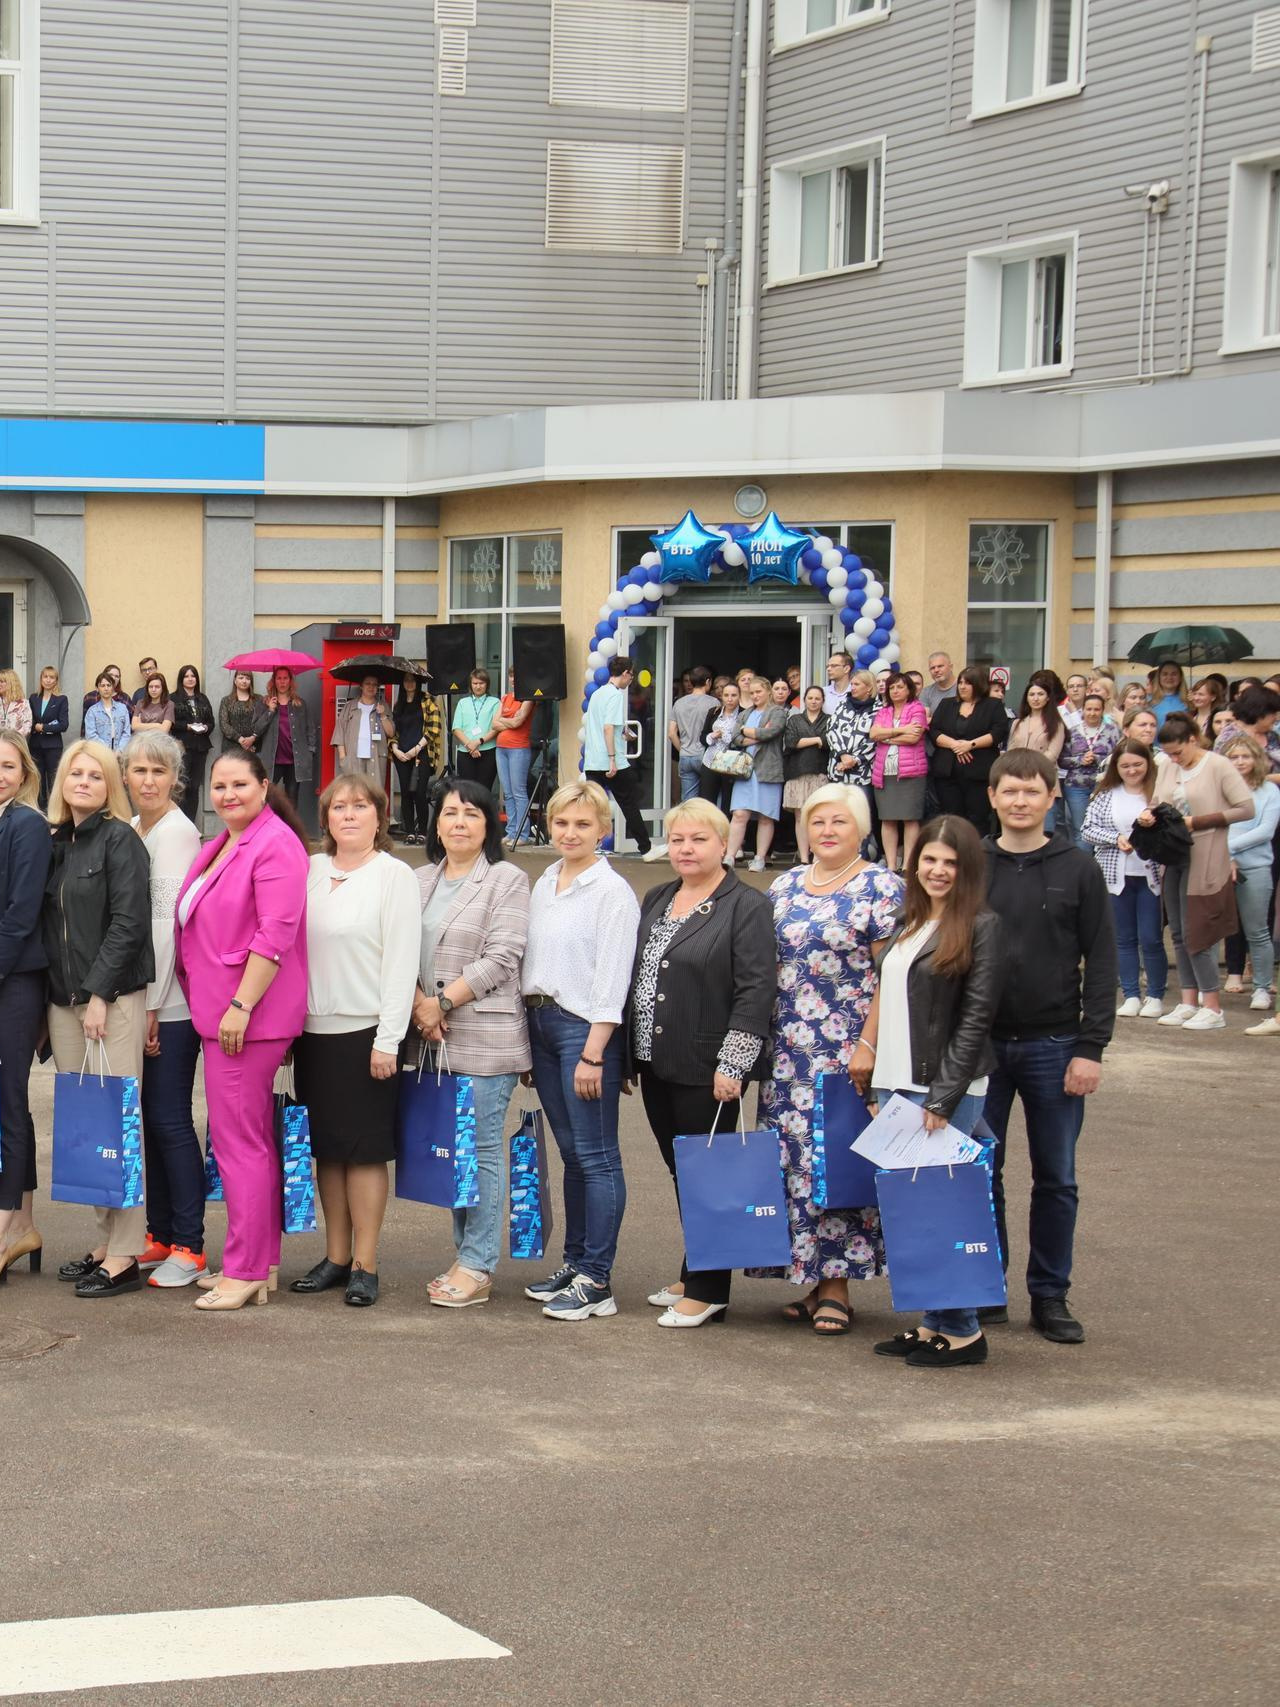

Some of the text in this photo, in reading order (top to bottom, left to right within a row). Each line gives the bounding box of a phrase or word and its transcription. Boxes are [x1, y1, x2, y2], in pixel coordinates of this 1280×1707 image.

[671, 544, 693, 555] ВТБ
[750, 540, 782, 553] РЦОП
[751, 553, 781, 565] 10 лет
[354, 628, 376, 636] КОФЕ
[102, 1148, 117, 1159] ВТБ
[436, 1147, 450, 1158] ВТБ
[755, 1205, 777, 1217] ВТБ
[965, 1242, 988, 1253] ВТБ
